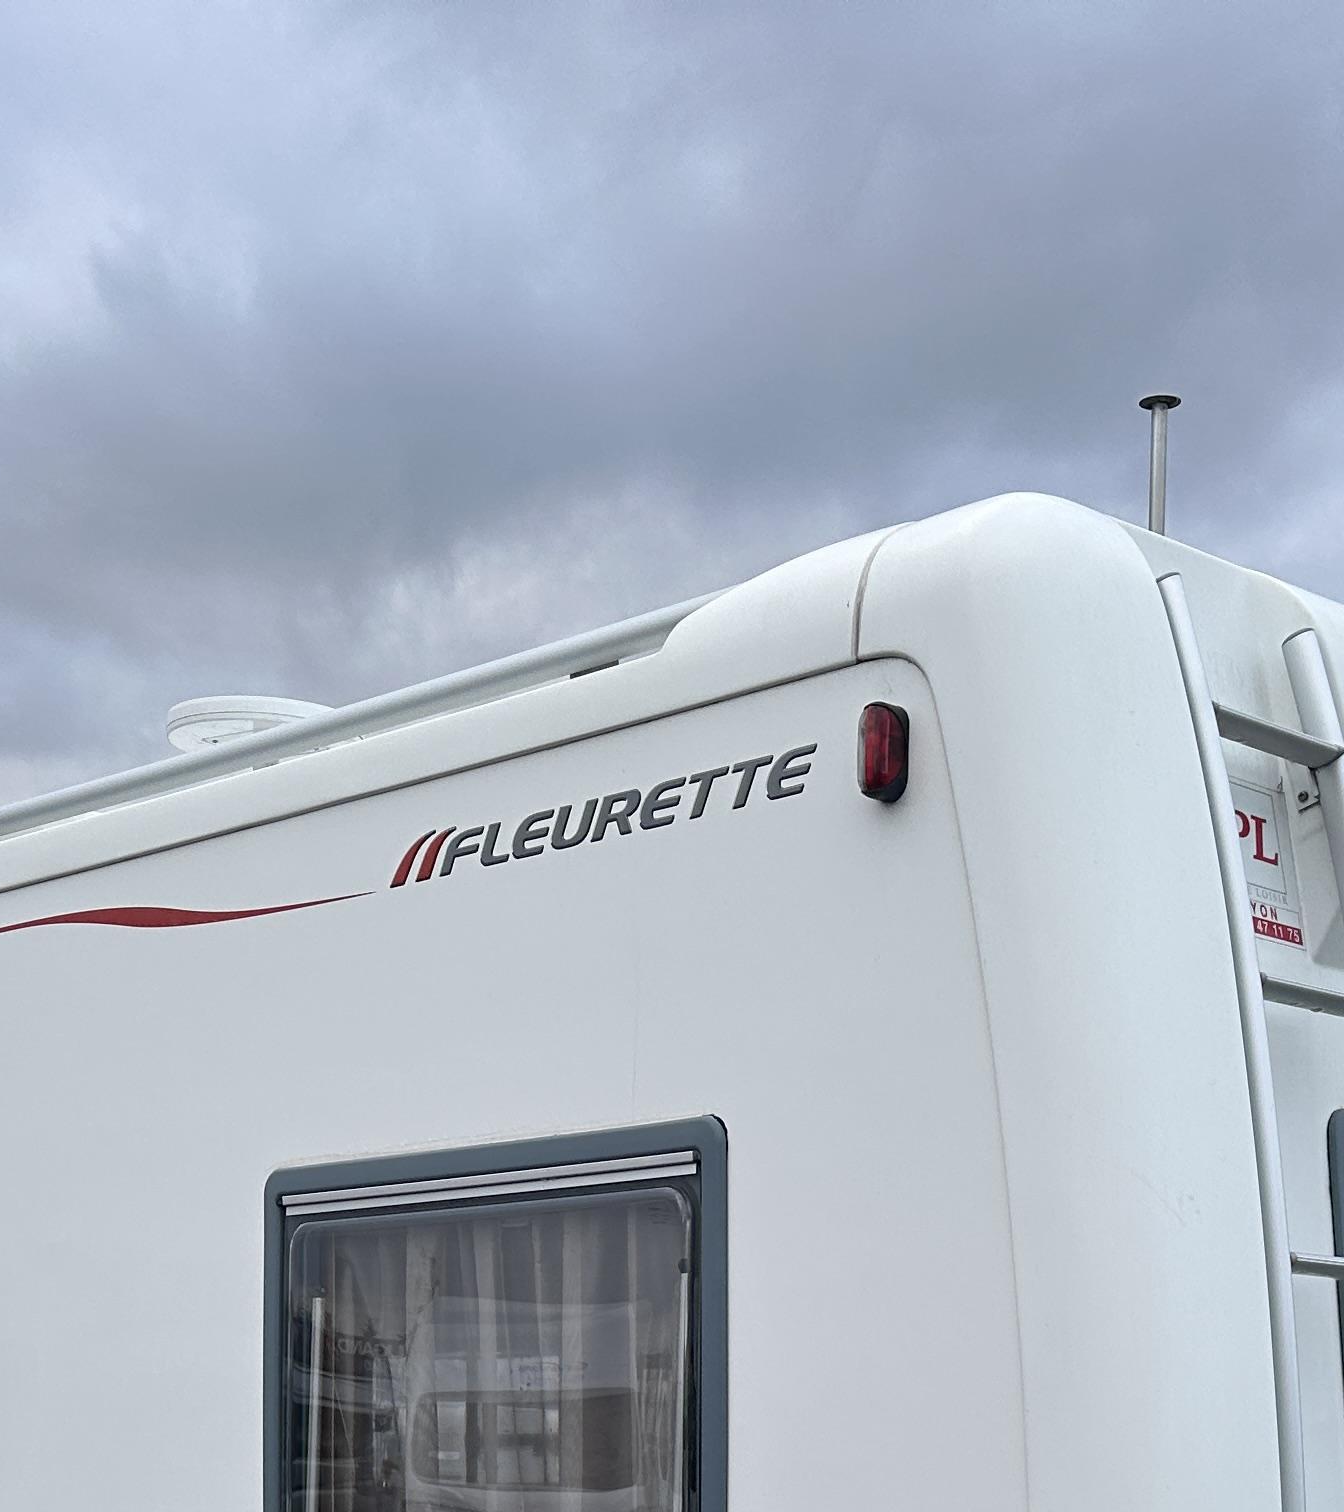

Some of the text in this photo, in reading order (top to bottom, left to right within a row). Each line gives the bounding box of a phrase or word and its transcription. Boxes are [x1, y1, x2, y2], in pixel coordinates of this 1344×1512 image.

[440, 743, 818, 877] FLEURETTE
[1257, 920, 1300, 943] 47 11 75
